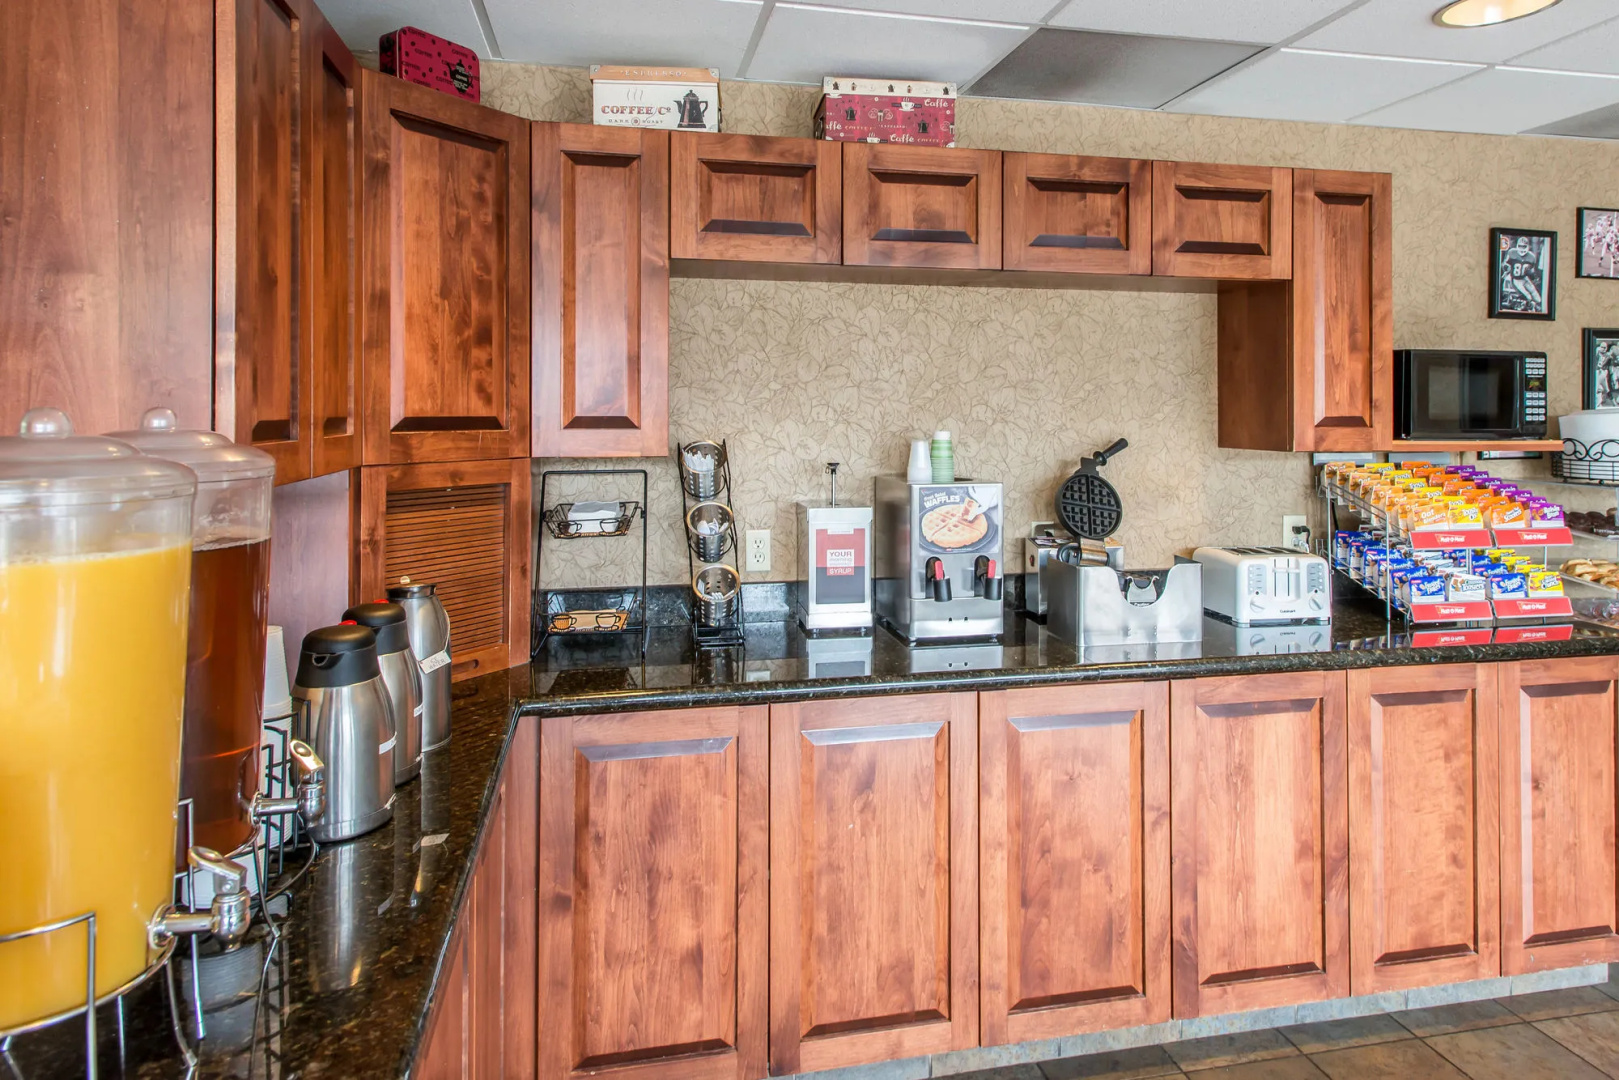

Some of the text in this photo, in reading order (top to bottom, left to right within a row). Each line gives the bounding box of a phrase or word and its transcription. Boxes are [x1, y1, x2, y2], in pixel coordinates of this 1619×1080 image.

[601, 105, 653, 115] COFFEE
[924, 495, 960, 508] WAFFLES
[1421, 509, 1434, 519] Oat
